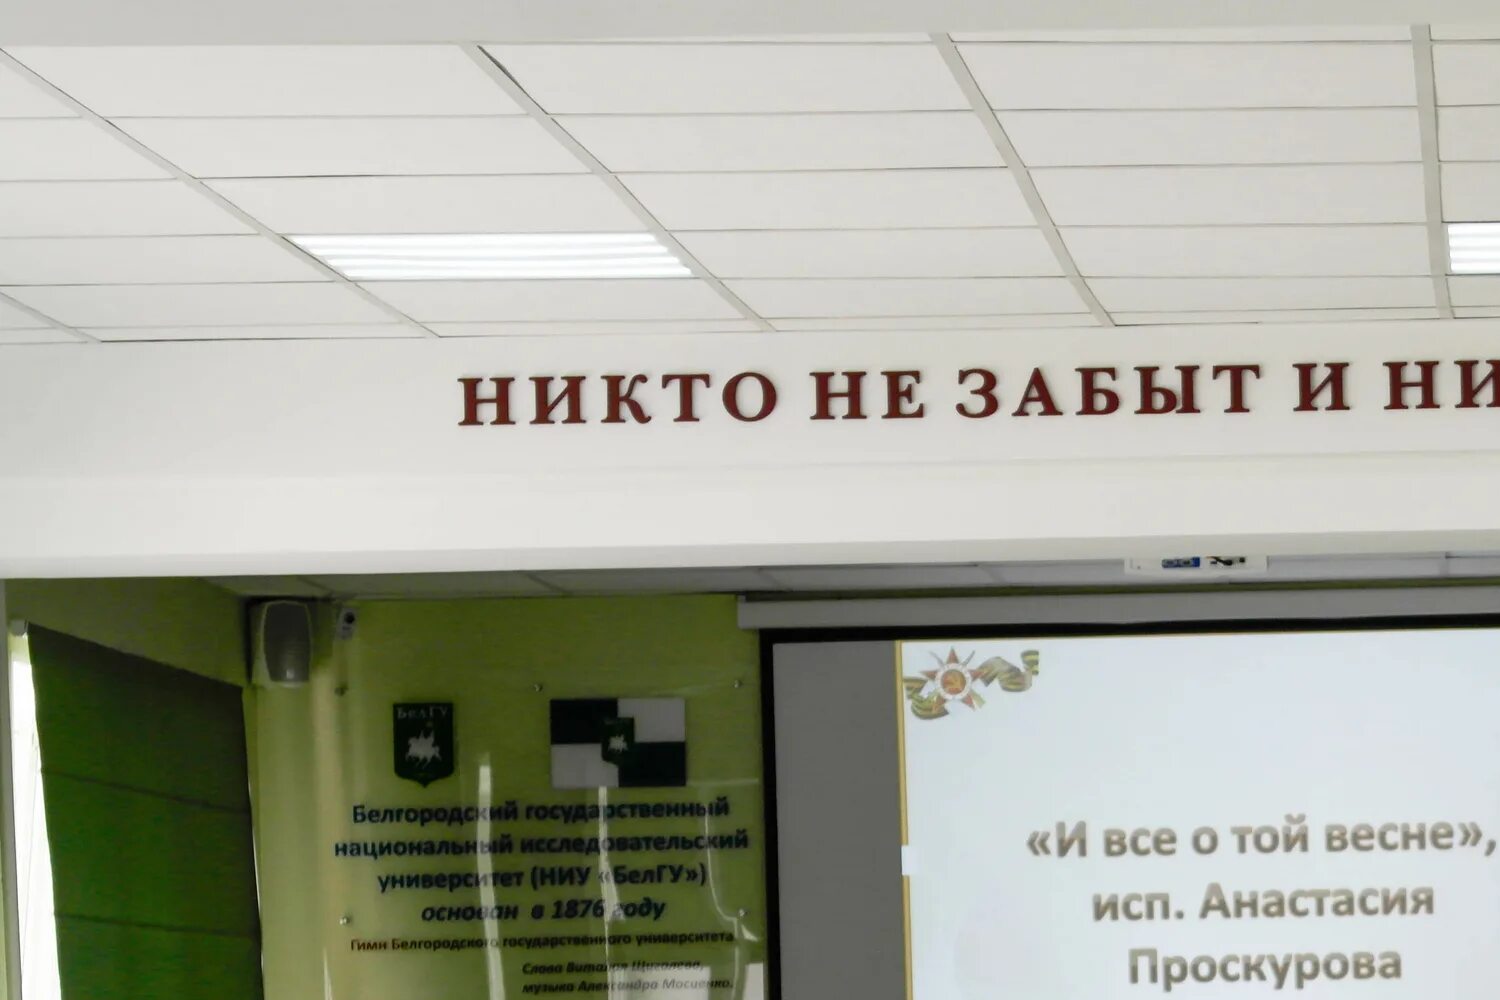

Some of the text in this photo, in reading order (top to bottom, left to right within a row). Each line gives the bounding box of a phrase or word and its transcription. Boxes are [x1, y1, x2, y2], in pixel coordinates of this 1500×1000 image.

[457, 371, 778, 426] НИКТО
[810, 369, 926, 420] НЕ
[955, 363, 1261, 419] ЗАБЫТ
[1292, 362, 1351, 412] И
[352, 796, 729, 826] Белгородский государственный
[334, 828, 748, 860] национальный исследовательский
[1026, 813, 1497, 858] «И все о той весне»,
[377, 871, 524, 893] университет
[531, 865, 590, 890] (НИУ
[421, 905, 519, 921] основан
[552, 900, 605, 919] 1876
[1093, 882, 1436, 921] исп. Анастасия
[1128, 948, 1403, 993] Проскурова
